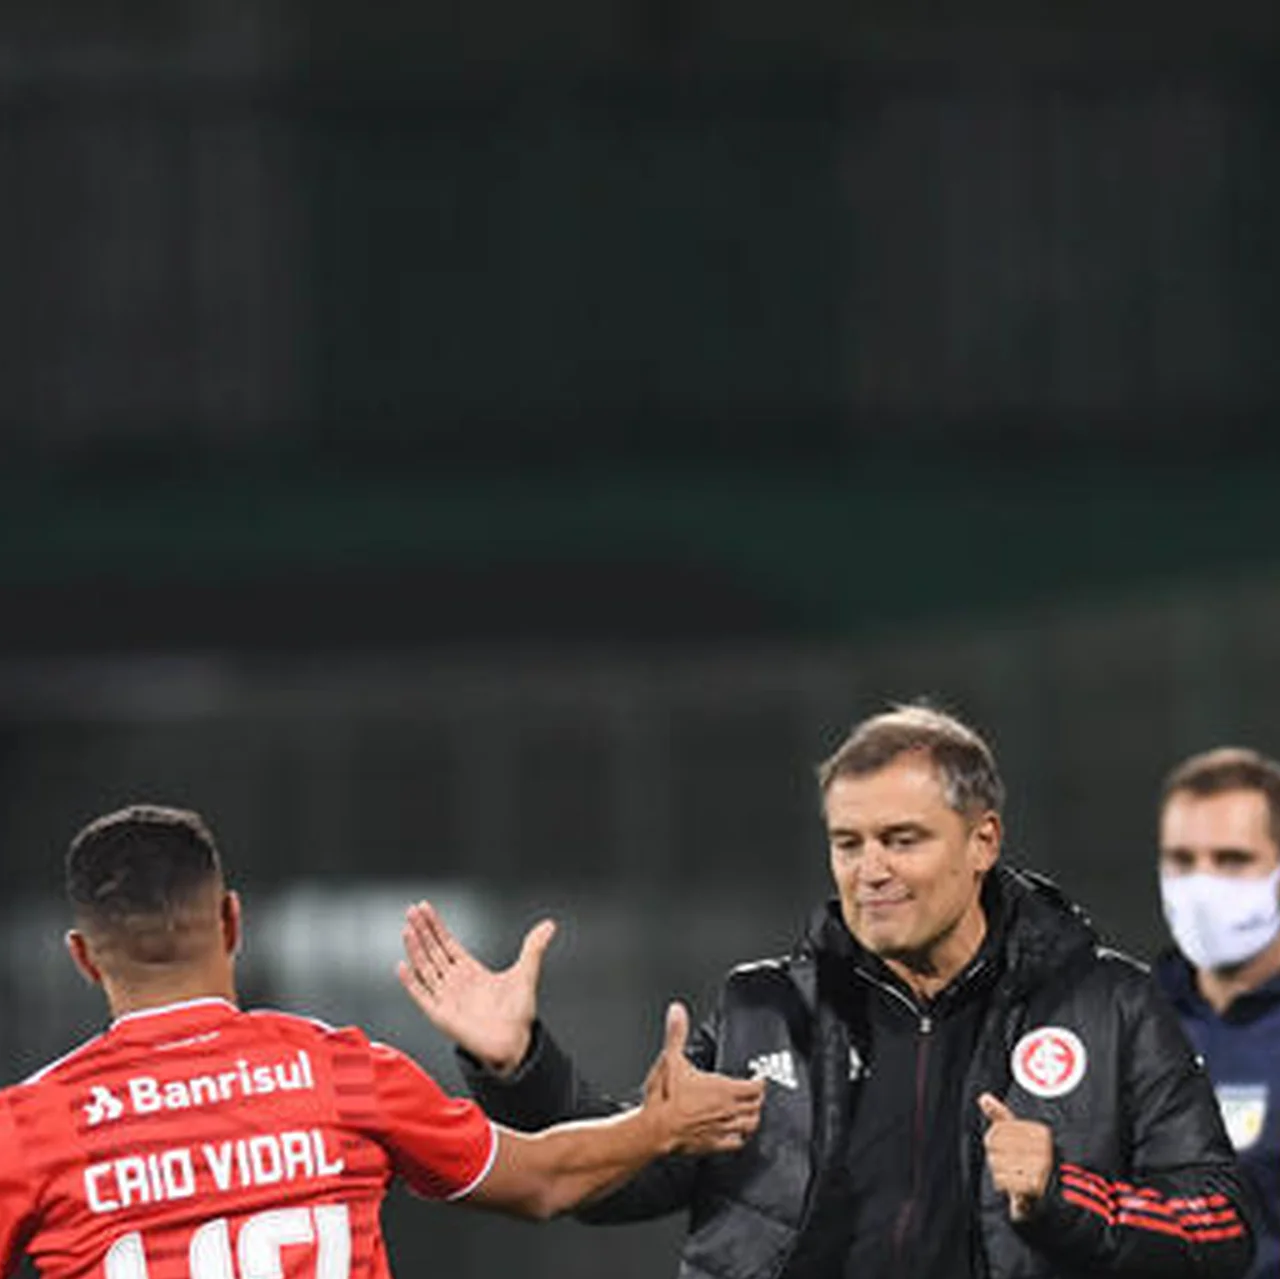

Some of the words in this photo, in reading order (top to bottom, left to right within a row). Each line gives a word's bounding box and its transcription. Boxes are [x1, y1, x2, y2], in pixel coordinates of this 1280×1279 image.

[128, 1050, 313, 1114] Banrisul
[84, 1149, 195, 1213] CAIO
[202, 1129, 344, 1190] VIDAL
